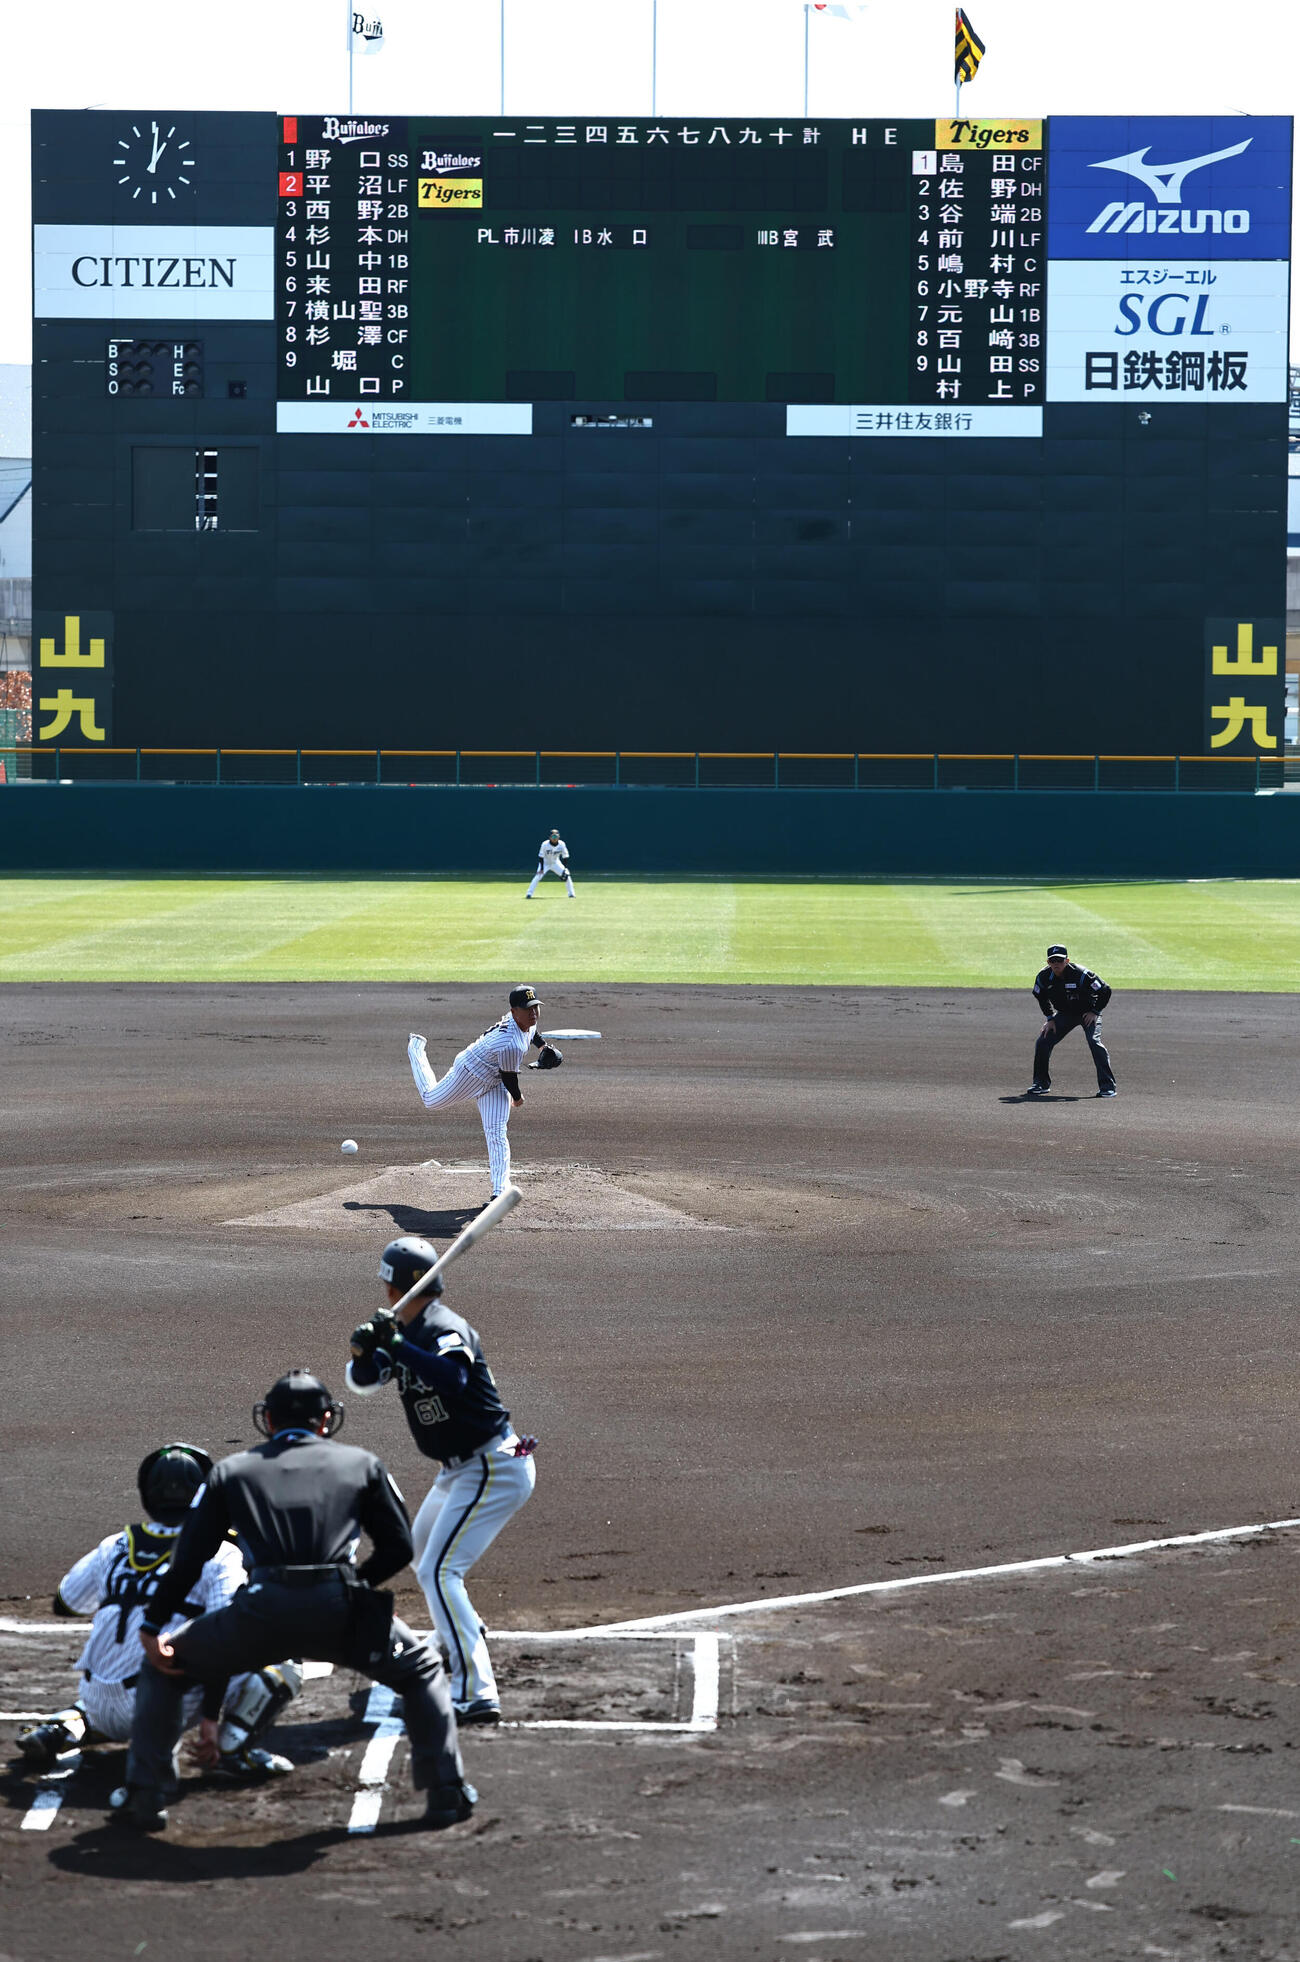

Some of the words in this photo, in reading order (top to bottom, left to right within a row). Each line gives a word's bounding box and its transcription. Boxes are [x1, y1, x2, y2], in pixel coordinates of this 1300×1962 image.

[322, 117, 390, 144] Buffaloes
[852, 127, 867, 145] H
[884, 128, 897, 145] E
[949, 119, 1030, 149] Tigers
[287, 150, 294, 166] 1
[387, 153, 409, 168] SS
[420, 150, 481, 174] Buffaloes
[921, 154, 928, 170] 1
[1021, 157, 1043, 171] CF
[285, 175, 297, 192] 2
[387, 178, 409, 193] LF
[421, 182, 481, 204] Tigers
[918, 179, 930, 196] 2
[1021, 182, 1042, 197] DH
[286, 200, 297, 217] 3
[387, 204, 409, 219] 2B
[918, 204, 930, 221] 3
[1020, 207, 1042, 222] 2B
[285, 226, 297, 242] 4
[387, 229, 408, 244] DH
[477, 228, 500, 244] PL
[917, 230, 929, 246] 4
[1020, 232, 1041, 247] LF
[285, 251, 297, 267] 5
[388, 254, 409, 269] 1B
[918, 254, 929, 271] 5
[1024, 258, 1037, 272] C
[71, 256, 237, 288] CITIZEN
[1119, 269, 1217, 286] エスジーエル
[285, 276, 297, 293] 6
[387, 279, 409, 294] RF
[917, 280, 929, 296] 6
[1019, 283, 1041, 297] RF
[285, 301, 297, 318] 7
[387, 304, 409, 319] 3B
[917, 305, 929, 322] 7
[1020, 308, 1041, 323] 1B
[285, 326, 297, 343] 8
[387, 329, 408, 344] CF
[916, 330, 929, 347] 8
[1018, 333, 1040, 348] 3B
[108, 344, 118, 359] B
[173, 345, 184, 359] H
[285, 351, 297, 368] 9
[391, 354, 404, 369] C
[109, 362, 118, 377] S
[173, 363, 184, 377] E
[916, 355, 928, 372] 9
[1018, 358, 1040, 373] SS
[1084, 350, 1249, 392] 日鉄鋼板
[392, 379, 404, 394] P
[1024, 383, 1036, 397] P
[371, 412, 419, 421] MITSUBISHI
[371, 420, 412, 429] ELECTRIC
[428, 416, 463, 426] 三菱電機
[855, 411, 973, 431] 三井住友銀行
[39, 615, 106, 741] 山九
[1210, 623, 1278, 749] 山九
[414, 1395, 450, 1426] 61
